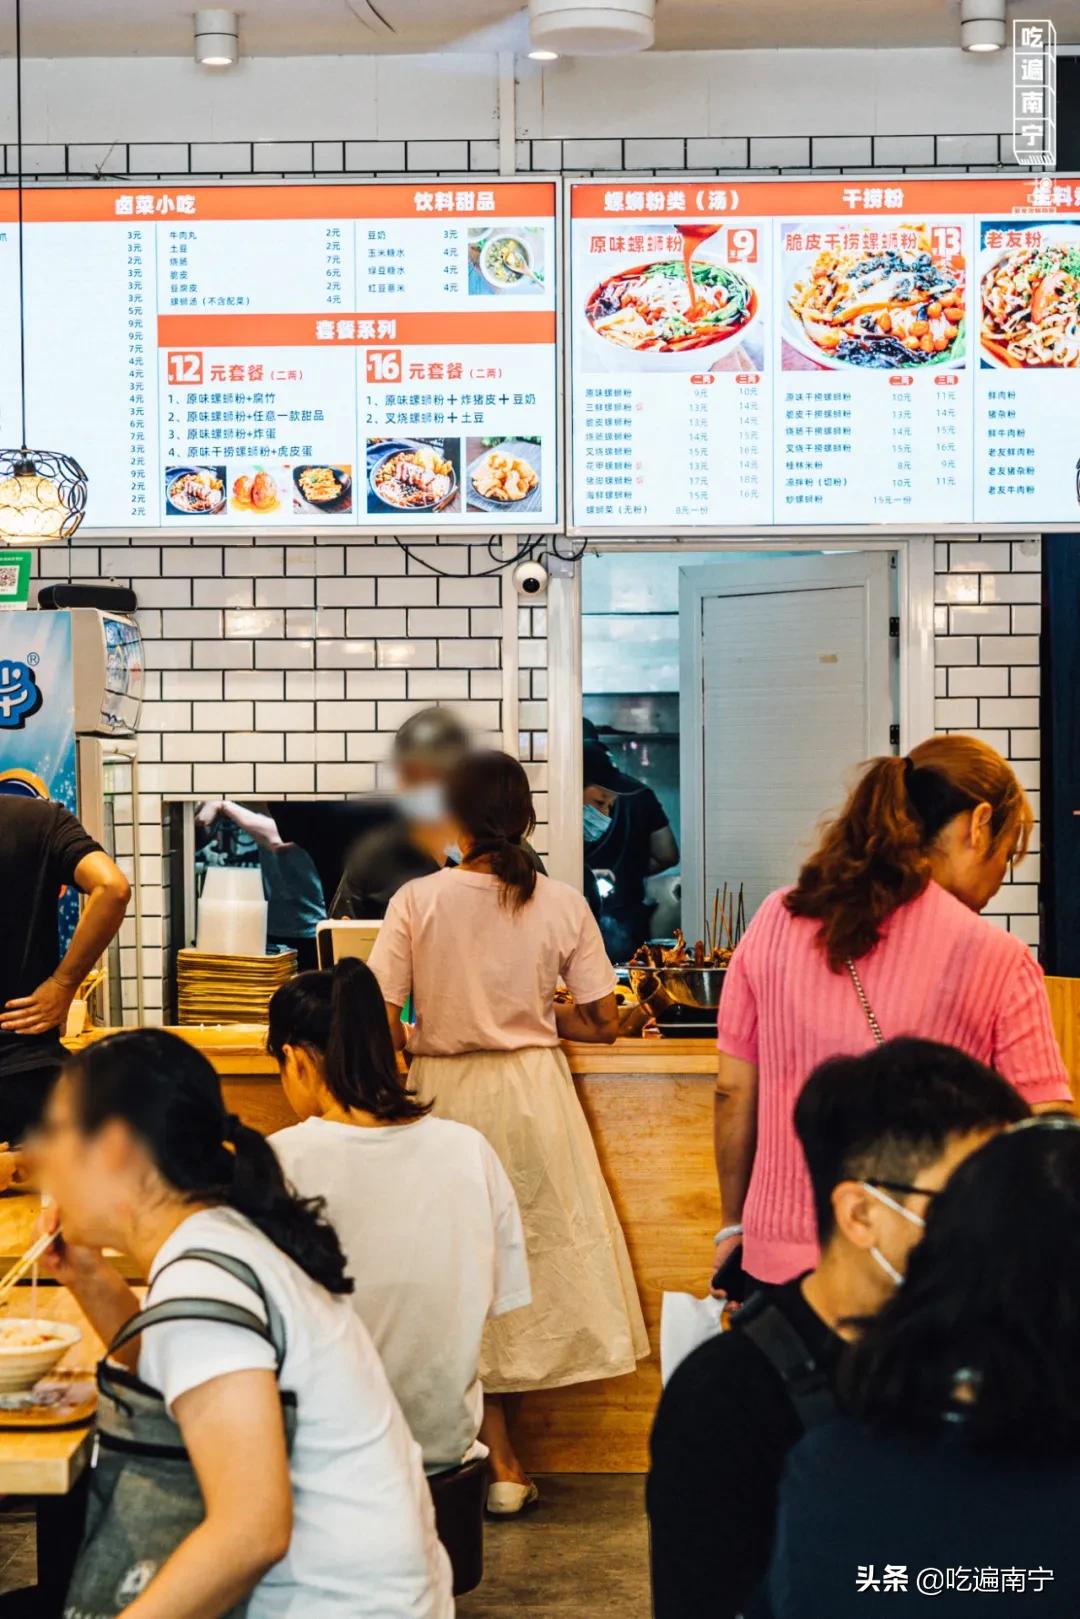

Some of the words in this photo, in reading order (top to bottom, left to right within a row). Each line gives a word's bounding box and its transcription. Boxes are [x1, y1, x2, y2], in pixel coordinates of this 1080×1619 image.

[414, 191, 495, 211] 饮料甜品
[604, 190, 739, 212] 螺蛳粉类（汤）
[842, 188, 904, 208] 干捞粉
[115, 194, 196, 215] 卤菜小吃
[127, 231, 143, 239] 3元
[169, 231, 198, 240] 牛肉丸
[325, 228, 341, 237] 2元
[367, 231, 387, 240] 豆奶
[443, 230, 459, 239] 3元
[588, 234, 684, 255] 原味螺蛳粉
[785, 232, 918, 252] 脆皮干捞螺蛳粉
[932, 228, 962, 257] 13
[985, 230, 1043, 250] 老友粉
[127, 244, 143, 252] 3元
[170, 244, 188, 253] 土豆
[325, 242, 341, 250] 2元
[442, 248, 459, 257] 4元
[127, 256, 143, 265] 2元
[326, 255, 341, 264] 7元
[127, 269, 143, 277] 3元
[325, 268, 342, 278] 6元
[442, 265, 459, 274] 4元
[127, 280, 143, 290] 3元
[325, 282, 342, 290] 2元
[443, 283, 459, 292] 4元
[127, 294, 144, 302] 3元
[325, 295, 342, 304] 4元
[127, 307, 144, 315] 5元
[127, 319, 144, 328] 9元
[316, 320, 396, 340] 套餐系列
[127, 332, 144, 340] 9元
[128, 344, 144, 353] 7元
[128, 357, 145, 366] 4元
[170, 354, 201, 382] 12
[368, 352, 400, 381] 16
[128, 369, 145, 378] 4元
[127, 382, 145, 391] 3元
[128, 394, 145, 403] 4元
[130, 407, 145, 416] 3元
[129, 420, 145, 428] 6元
[130, 432, 145, 440] 7元
[130, 445, 145, 453] 3元
[129, 457, 146, 465] 2元
[130, 469, 146, 478] 9元
[130, 482, 146, 490] 2元
[131, 494, 146, 503] 2元
[130, 507, 147, 516] 2元
